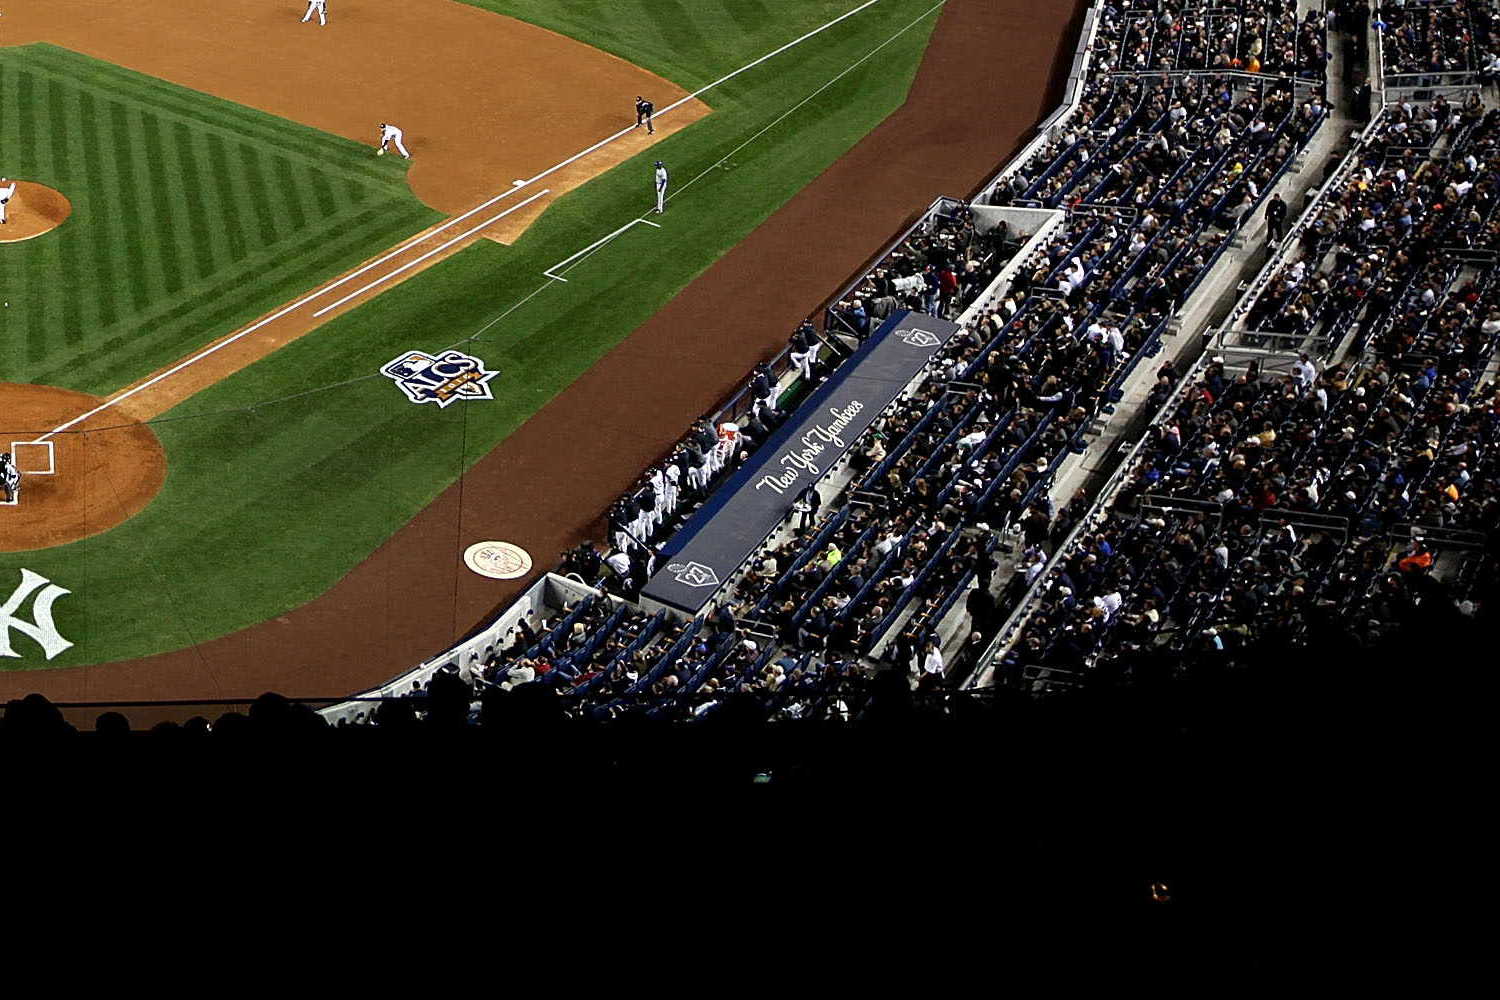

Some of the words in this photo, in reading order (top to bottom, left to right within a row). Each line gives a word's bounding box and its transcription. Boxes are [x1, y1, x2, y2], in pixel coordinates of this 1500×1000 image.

[404, 353, 476, 401] ALCS
[755, 466, 799, 494] New
[780, 437, 825, 475] York
[806, 400, 864, 448] Yankees
